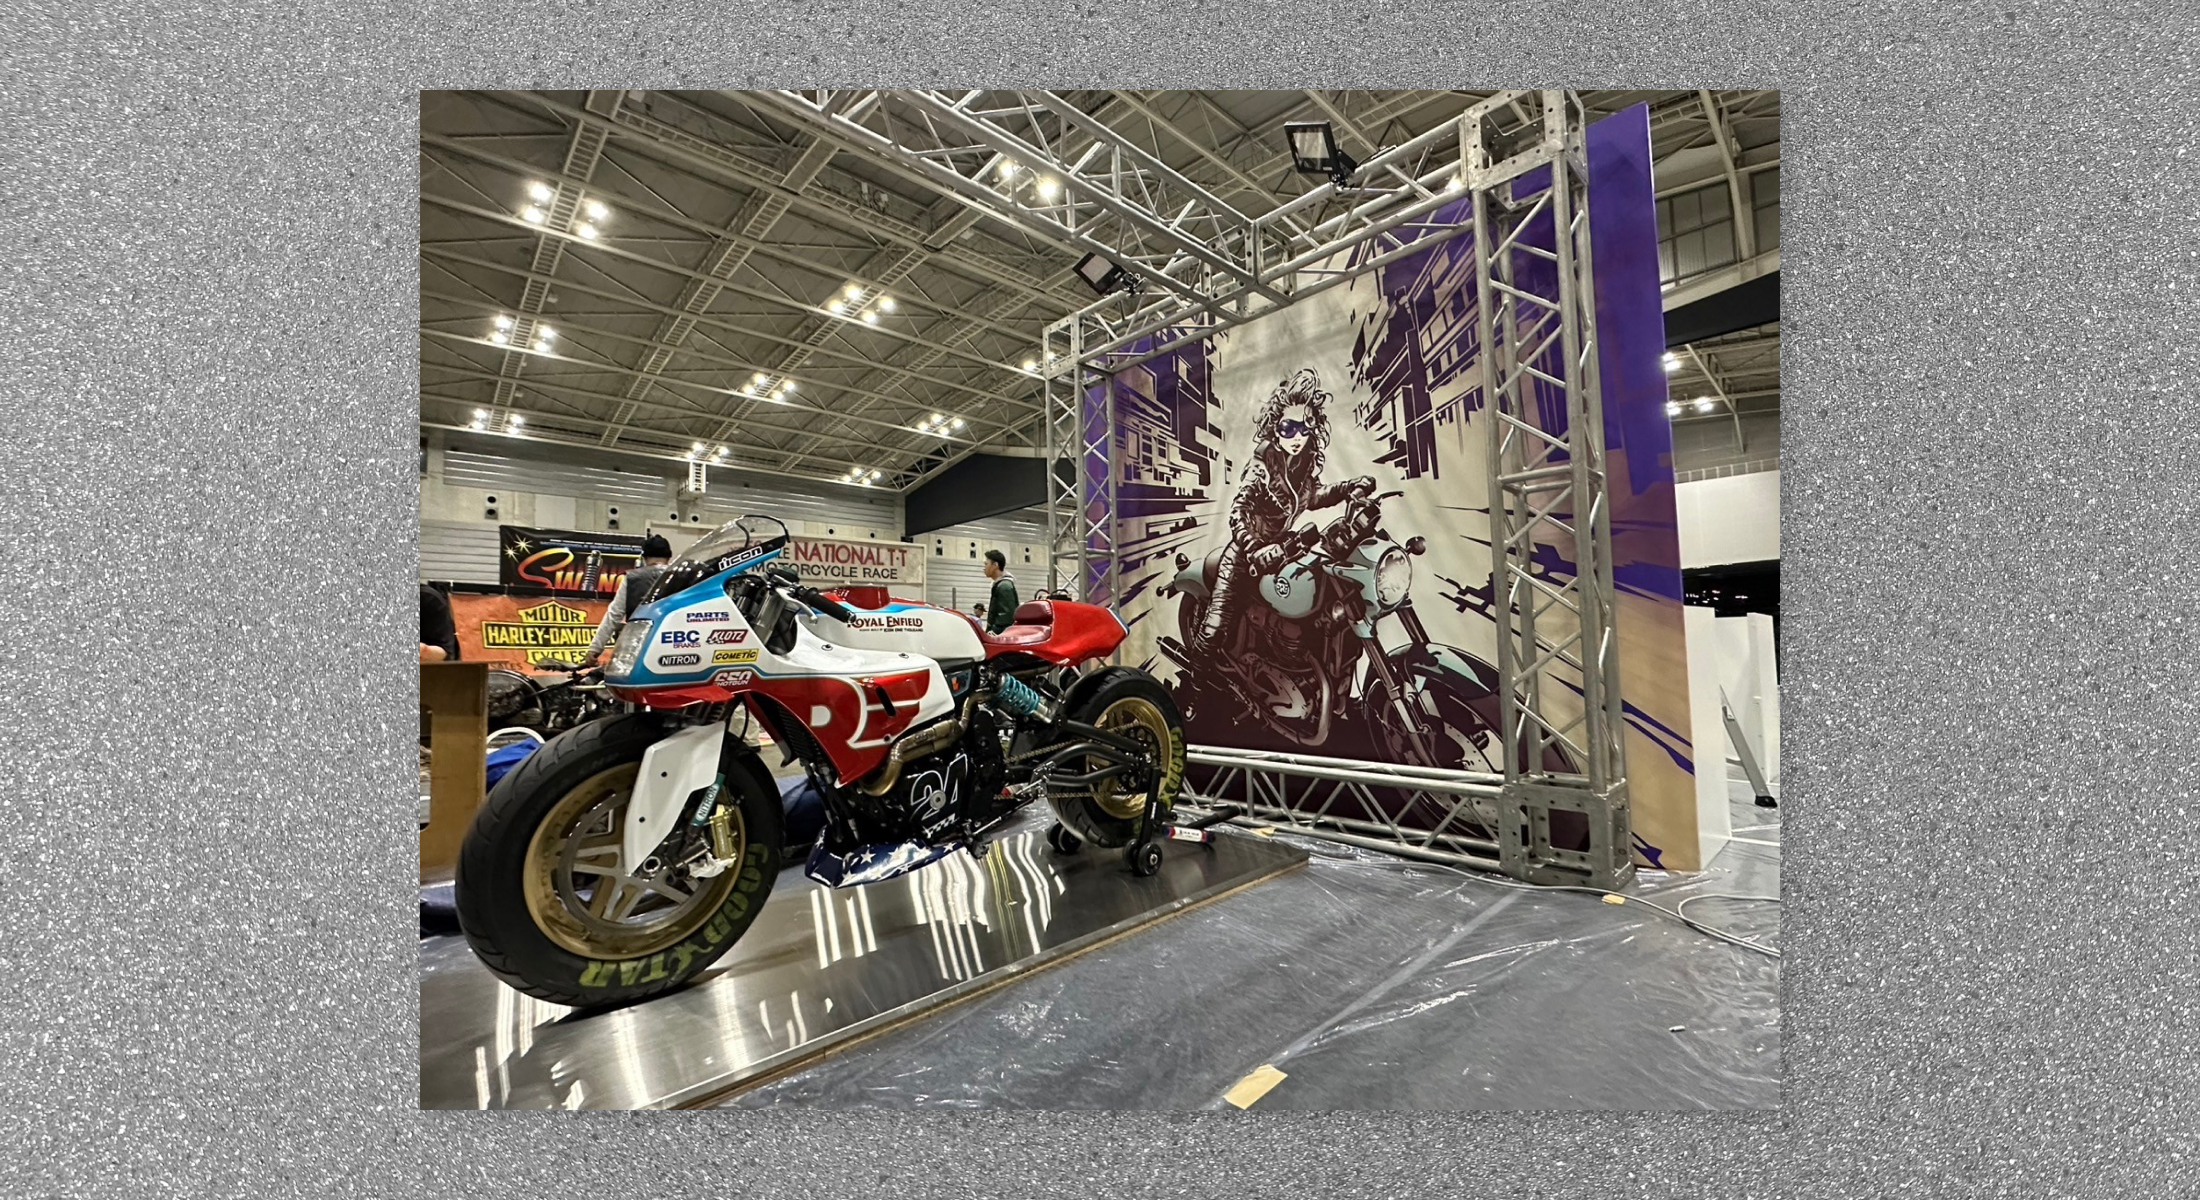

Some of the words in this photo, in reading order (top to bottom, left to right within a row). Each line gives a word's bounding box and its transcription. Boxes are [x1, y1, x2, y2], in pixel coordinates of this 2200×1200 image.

[794, 541, 885, 566] NATIONAL
[862, 565, 898, 579] RACE
[525, 603, 582, 622] MOTOR
[847, 616, 884, 628] OYAL
[886, 615, 923, 628] ENFIELD
[661, 630, 700, 643] EBC
[711, 630, 745, 641] KLOTZ
[531, 650, 586, 664] CYCLES
[661, 655, 698, 665] NITRON
[698, 784, 718, 819] NITRON
